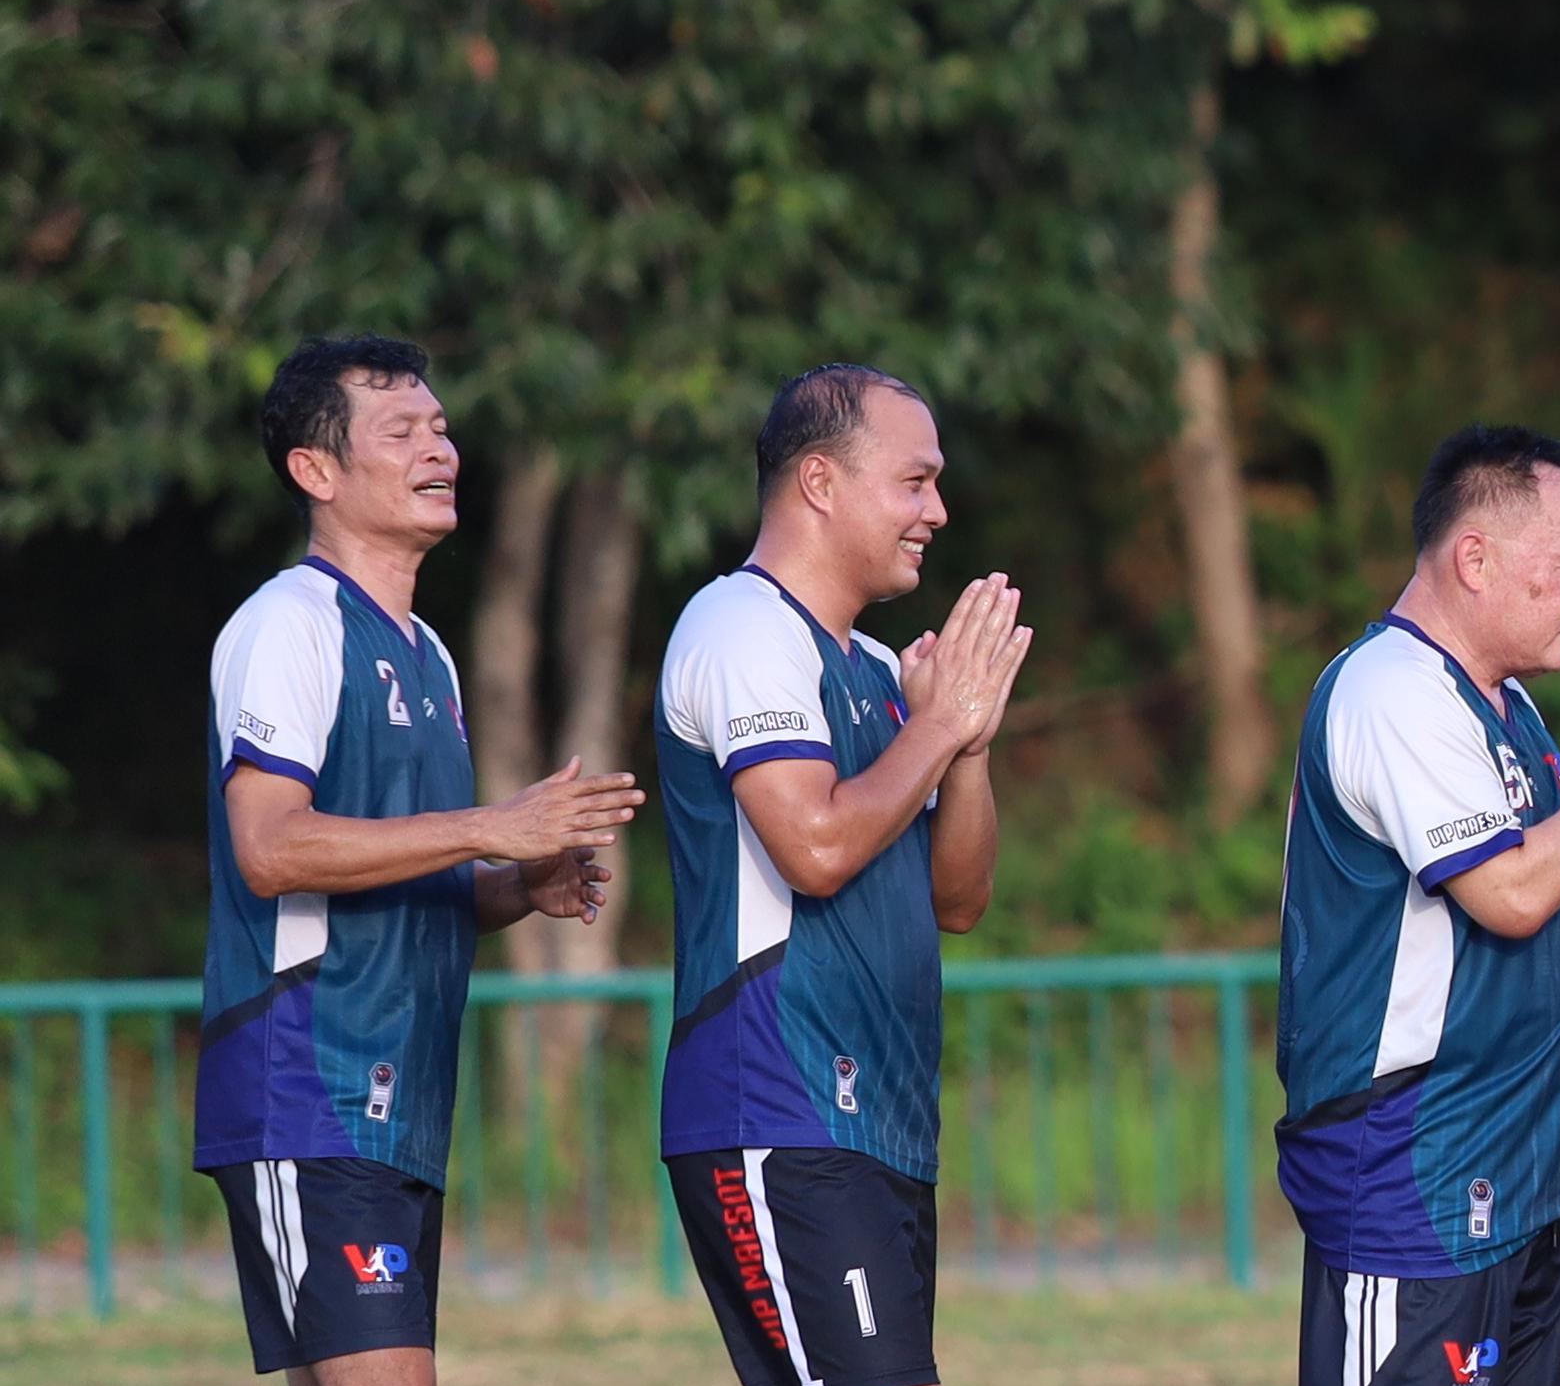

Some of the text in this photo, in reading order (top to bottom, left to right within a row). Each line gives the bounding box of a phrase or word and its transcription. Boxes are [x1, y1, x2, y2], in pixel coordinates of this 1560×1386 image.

[375, 659, 413, 728] 2
[727, 715, 751, 741] VIP
[1426, 822, 1454, 849] VIP
[713, 1167, 770, 1292] MAESOT
[842, 1267, 878, 1338] 1
